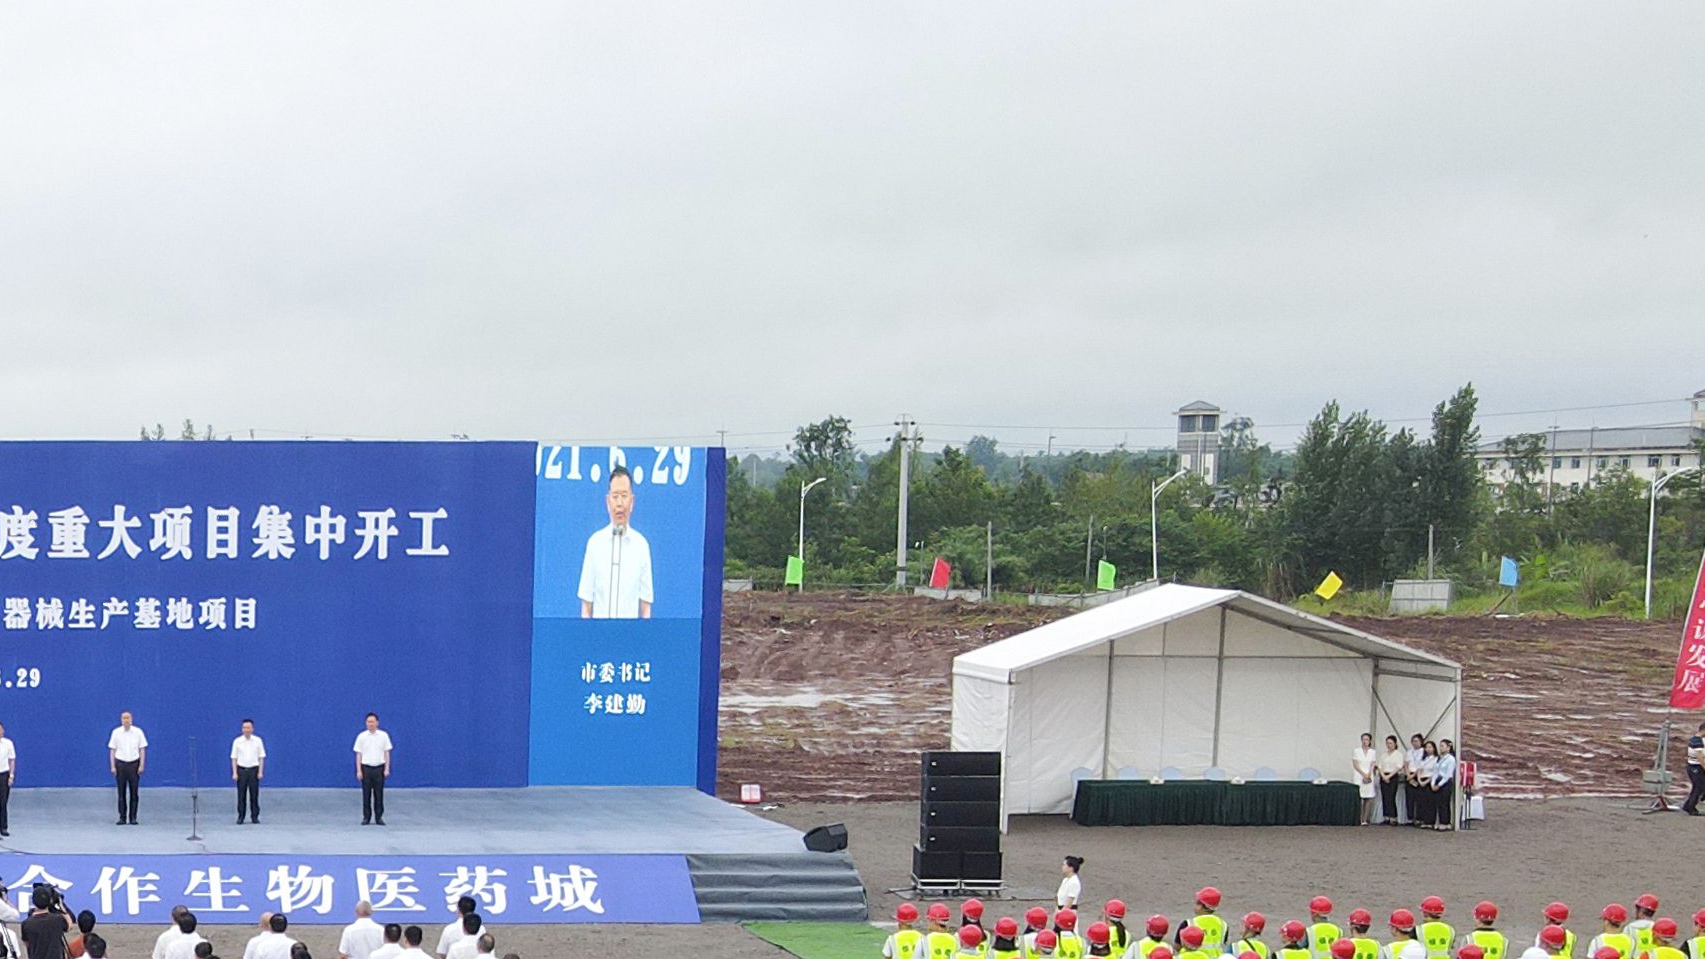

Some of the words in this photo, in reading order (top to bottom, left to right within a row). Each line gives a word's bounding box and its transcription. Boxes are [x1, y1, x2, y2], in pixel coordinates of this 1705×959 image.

[580, 662, 652, 684] 市委书记
[583, 692, 646, 715] 李建勤
